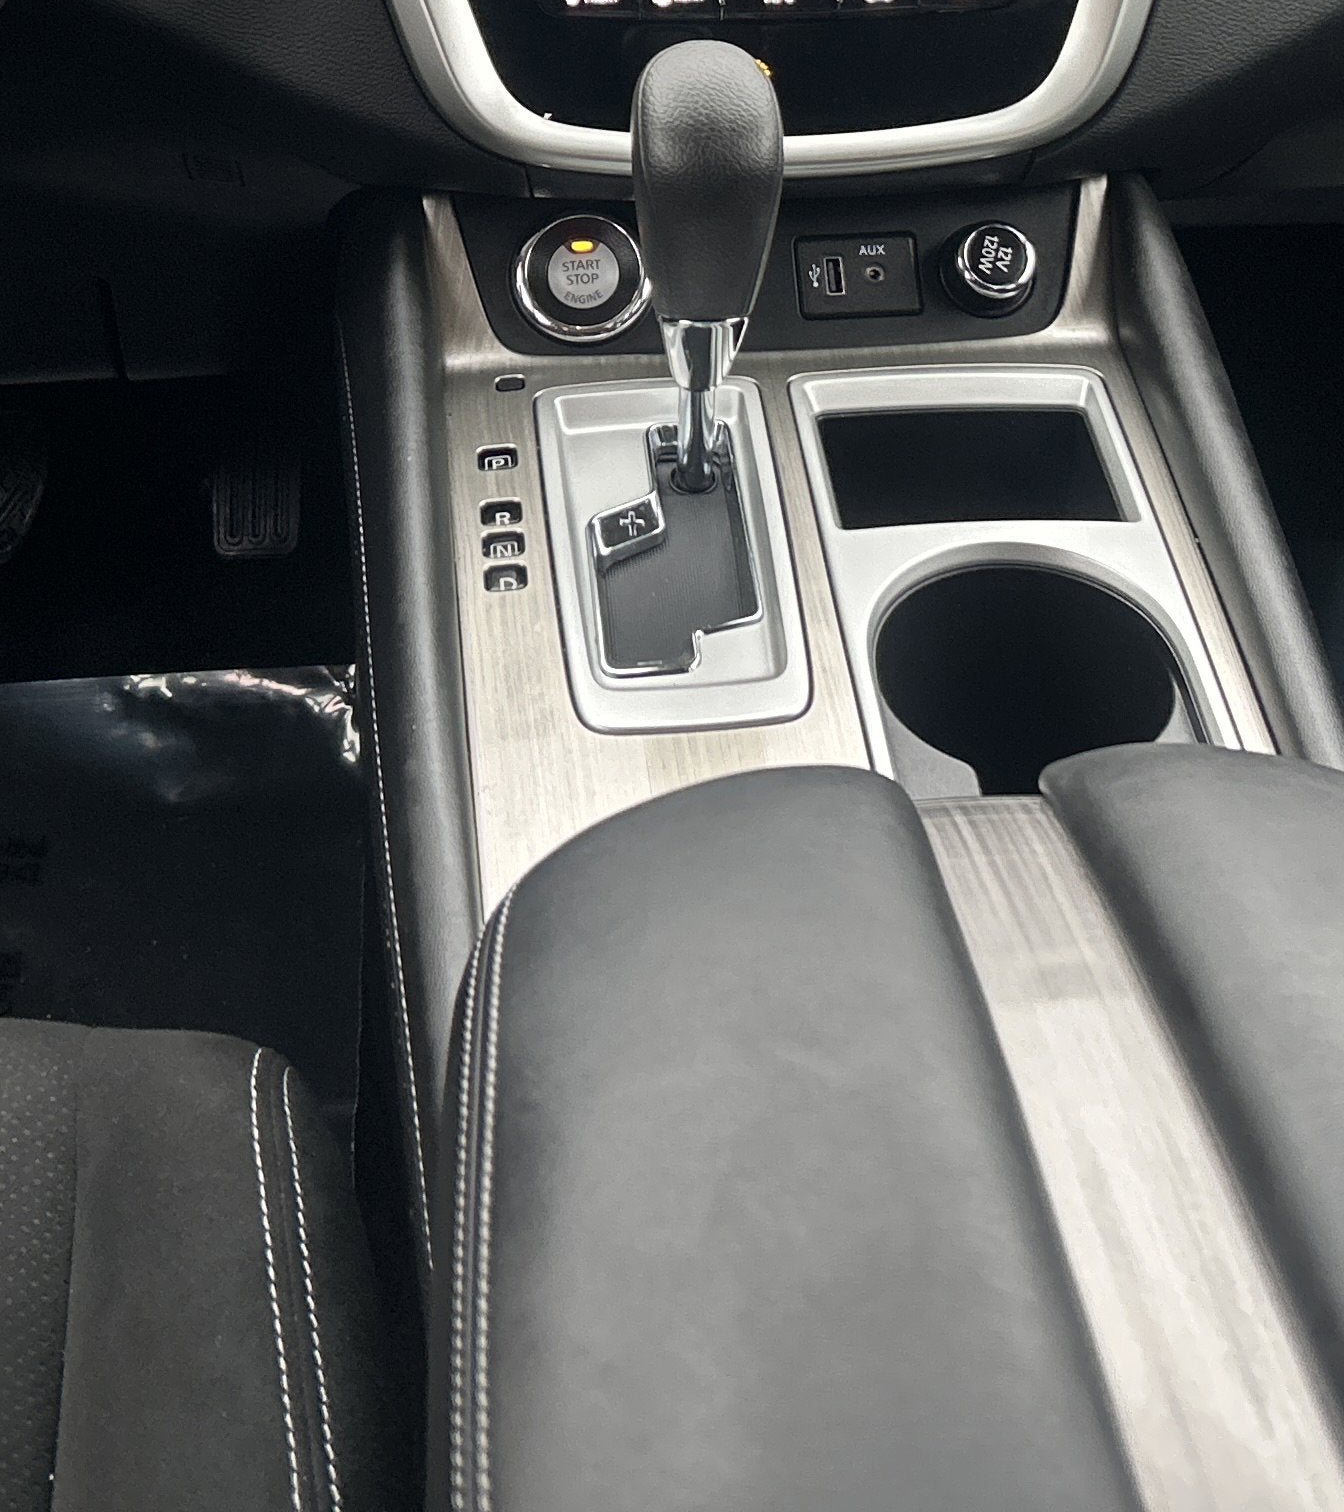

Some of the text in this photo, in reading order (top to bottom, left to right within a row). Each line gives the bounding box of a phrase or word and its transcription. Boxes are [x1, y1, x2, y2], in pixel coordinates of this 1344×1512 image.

[859, 245, 886, 256] AUX
[978, 235, 999, 275] 120W
[561, 259, 601, 272] START
[995, 247, 1012, 273] 12V
[566, 273, 599, 286] STOP
[563, 289, 604, 304] ENGINE
